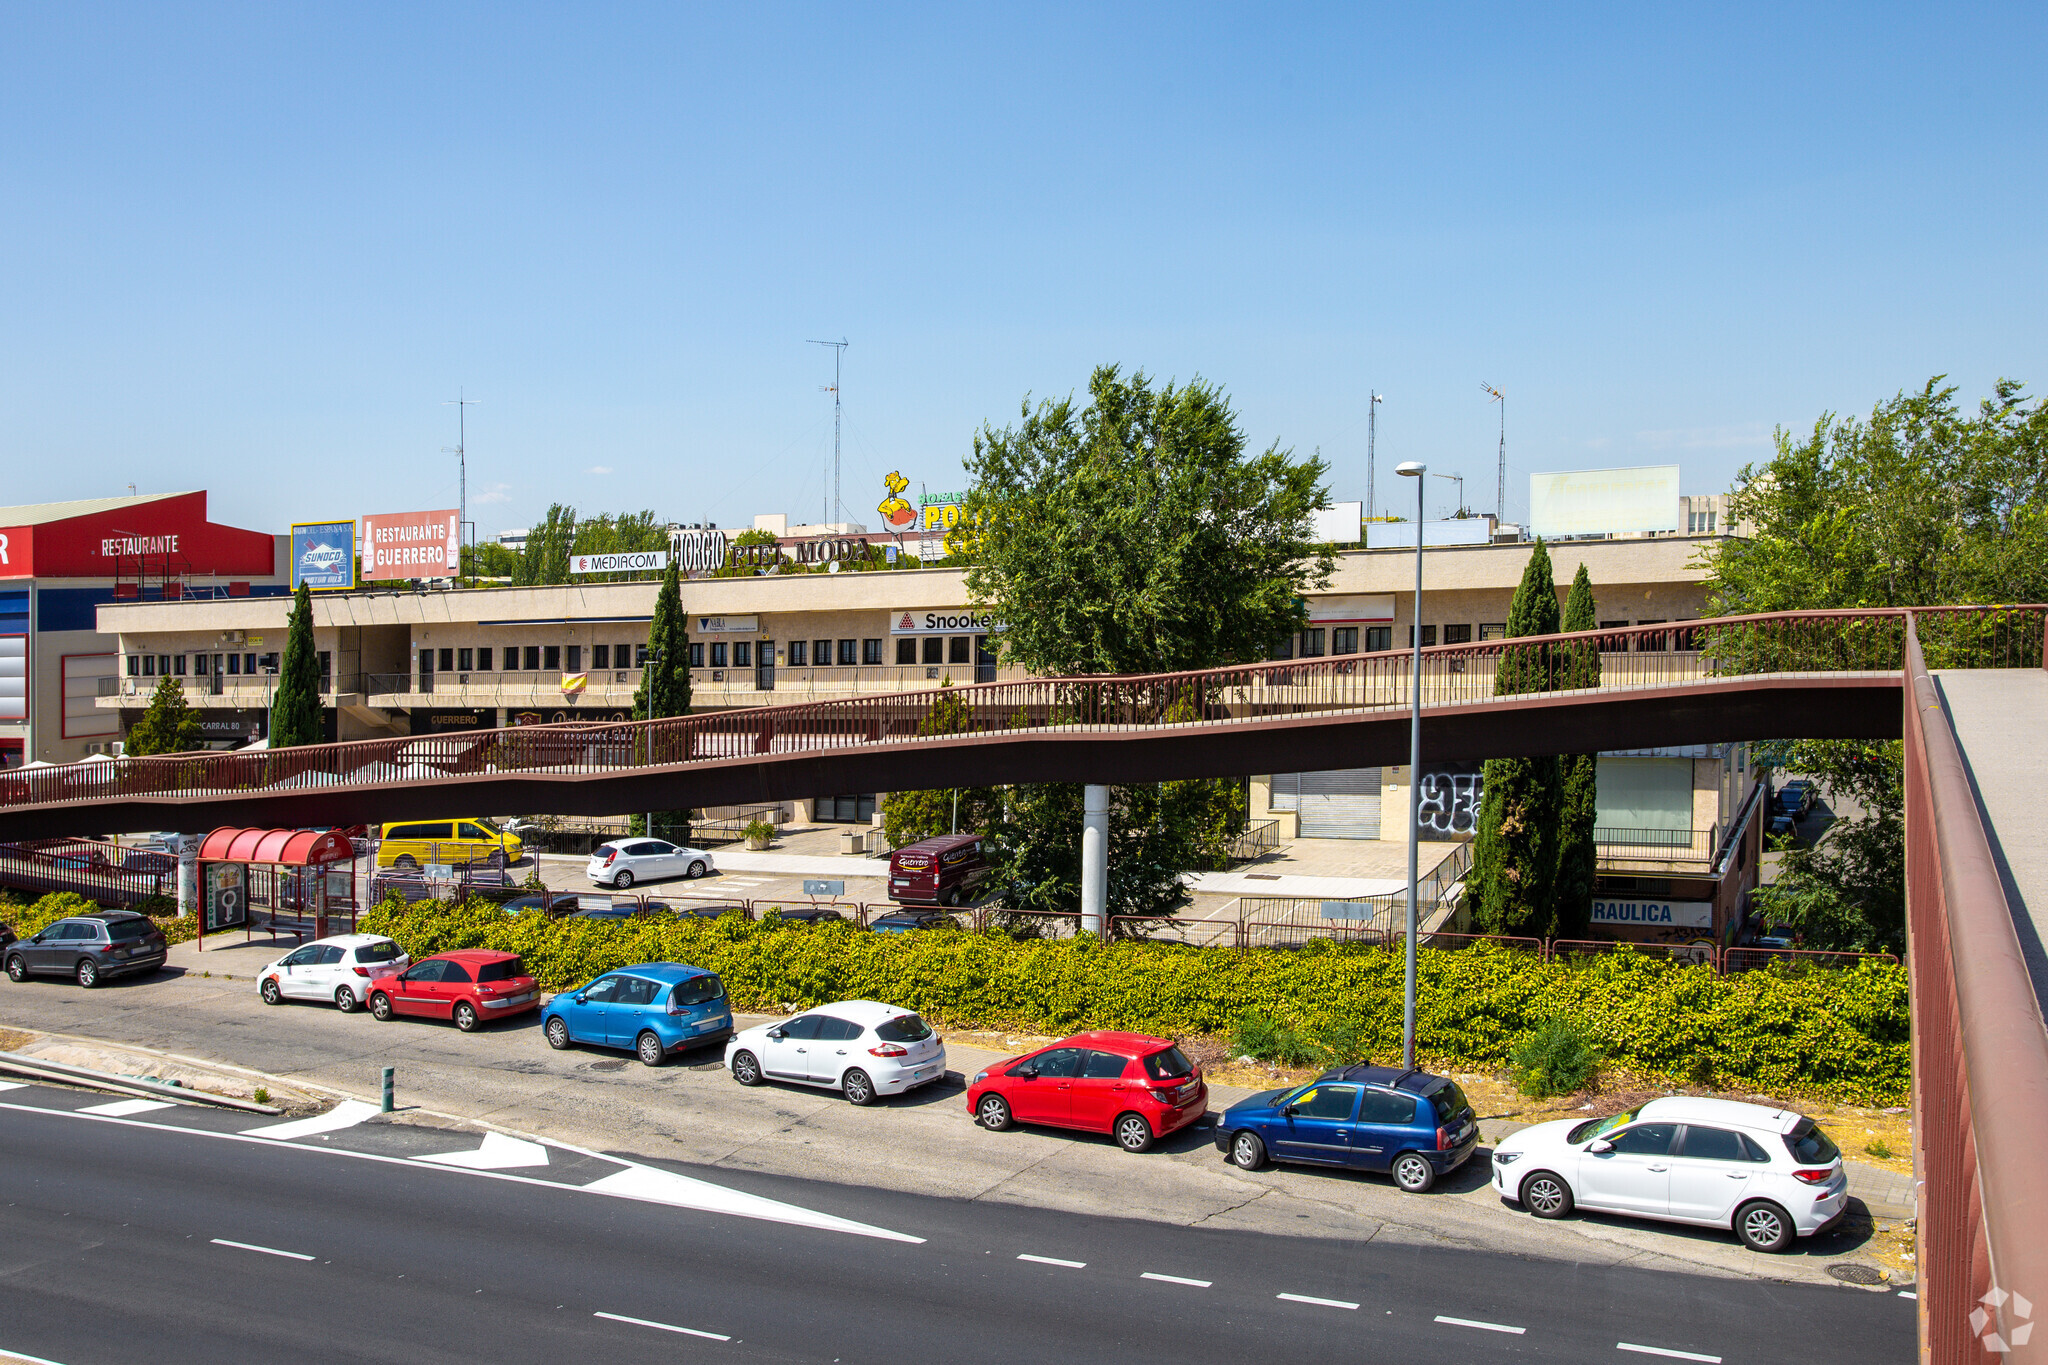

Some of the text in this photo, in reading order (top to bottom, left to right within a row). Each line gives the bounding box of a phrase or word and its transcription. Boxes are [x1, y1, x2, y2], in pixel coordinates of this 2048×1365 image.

[376, 524, 445, 543] RESTAURANTE
[102, 535, 179, 556] RESTAURANTE
[670, 531, 725, 571] GIORGIO
[731, 538, 872, 568] PIEL MODA
[305, 551, 341, 563] SUNOCO
[376, 546, 444, 566] GUERRERO
[591, 554, 657, 570] MEDIACOM
[304, 575, 343, 584] MOTOR OILS
[231, 722, 240, 730] 80
[431, 715, 478, 725] GUERRERO
[898, 858, 929, 866] Guerrero
